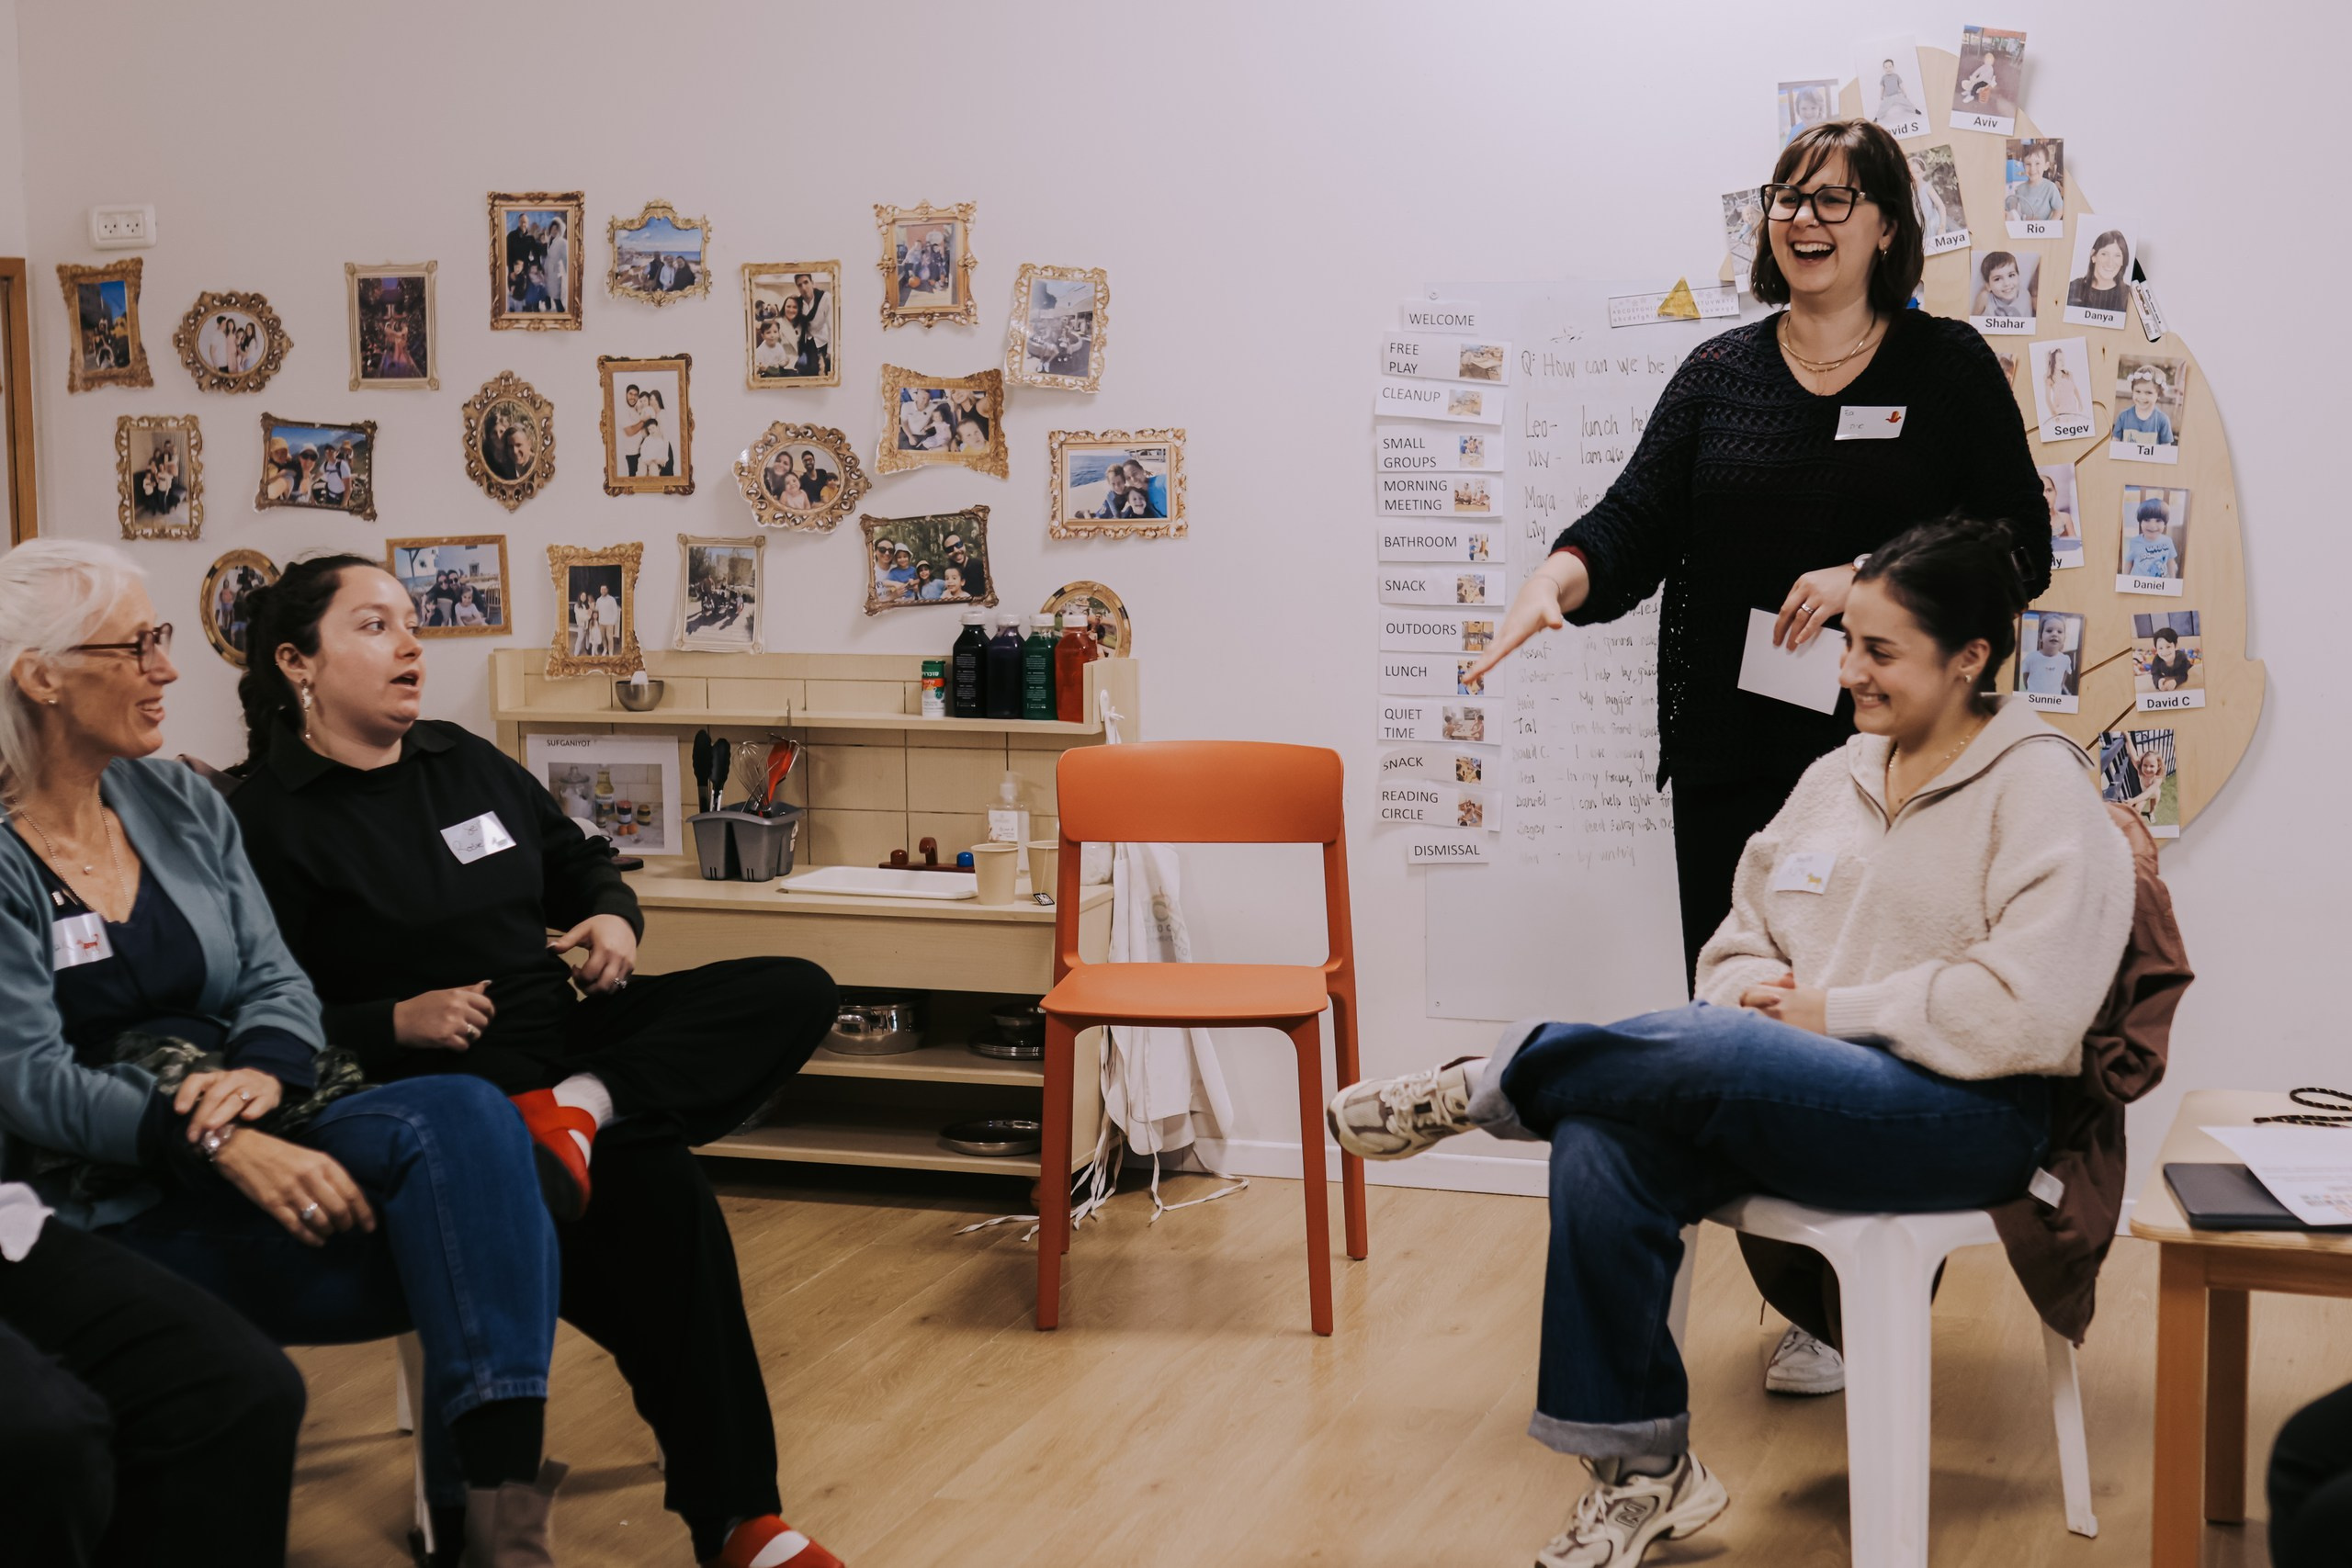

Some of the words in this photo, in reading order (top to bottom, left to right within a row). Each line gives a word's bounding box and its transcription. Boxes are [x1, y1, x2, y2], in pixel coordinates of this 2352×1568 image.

[1888, 123, 1908, 135] vid
[1911, 122, 1919, 132] S
[1973, 116, 1998, 129] Aviv
[2027, 223, 2045, 234] Rio
[1934, 232, 1966, 248] Maya
[1408, 313, 1476, 327] WELCOME
[2084, 310, 2115, 323] Danya
[1984, 317, 2026, 330] Shahar
[1389, 343, 1419, 355] FREE
[1389, 361, 1418, 375] PLAY
[1544, 353, 1575, 378] How
[1585, 359, 1608, 375] can
[1617, 356, 1638, 376] we
[1647, 354, 1665, 374] be
[1382, 387, 1441, 403] CLEANUP
[1582, 404, 1618, 438] lunch
[1631, 406, 1648, 434] hel
[2054, 423, 2090, 437] Segev
[1383, 437, 1426, 450] SMALL
[1605, 446, 1623, 464] also
[2137, 445, 2155, 457] Tal
[1384, 456, 1437, 468] GROUPS
[1384, 479, 1448, 492] MORNING
[1385, 499, 1442, 511] MEETING
[1524, 485, 1556, 517] Maya
[1525, 518, 1546, 546] Lily
[1384, 536, 1457, 548] BATHROOM
[2052, 556, 2063, 569] ly
[1385, 580, 1426, 592] SNACK
[2133, 580, 2165, 591] Daniel
[1385, 623, 1457, 636] OUTDOORS
[1385, 666, 1427, 678] LUNCH
[1578, 691, 1594, 712] My
[1604, 690, 1634, 716] bigger
[2028, 694, 2064, 705] Sunnie
[2146, 698, 2179, 709] David
[2181, 696, 2191, 707] C
[1384, 708, 1423, 721] QUIET
[1512, 716, 1537, 735] Tal
[1384, 727, 1416, 739] TIME
[546, 739, 591, 748] SUFGANIYOT
[1383, 757, 1424, 771] SNACK
[1382, 790, 1439, 804] READING
[1579, 798, 1598, 810] can
[1600, 792, 1622, 809] help
[1629, 792, 1655, 815] light
[1381, 807, 1424, 820] CIRCLE
[1414, 844, 1480, 856] DISMISSAL
